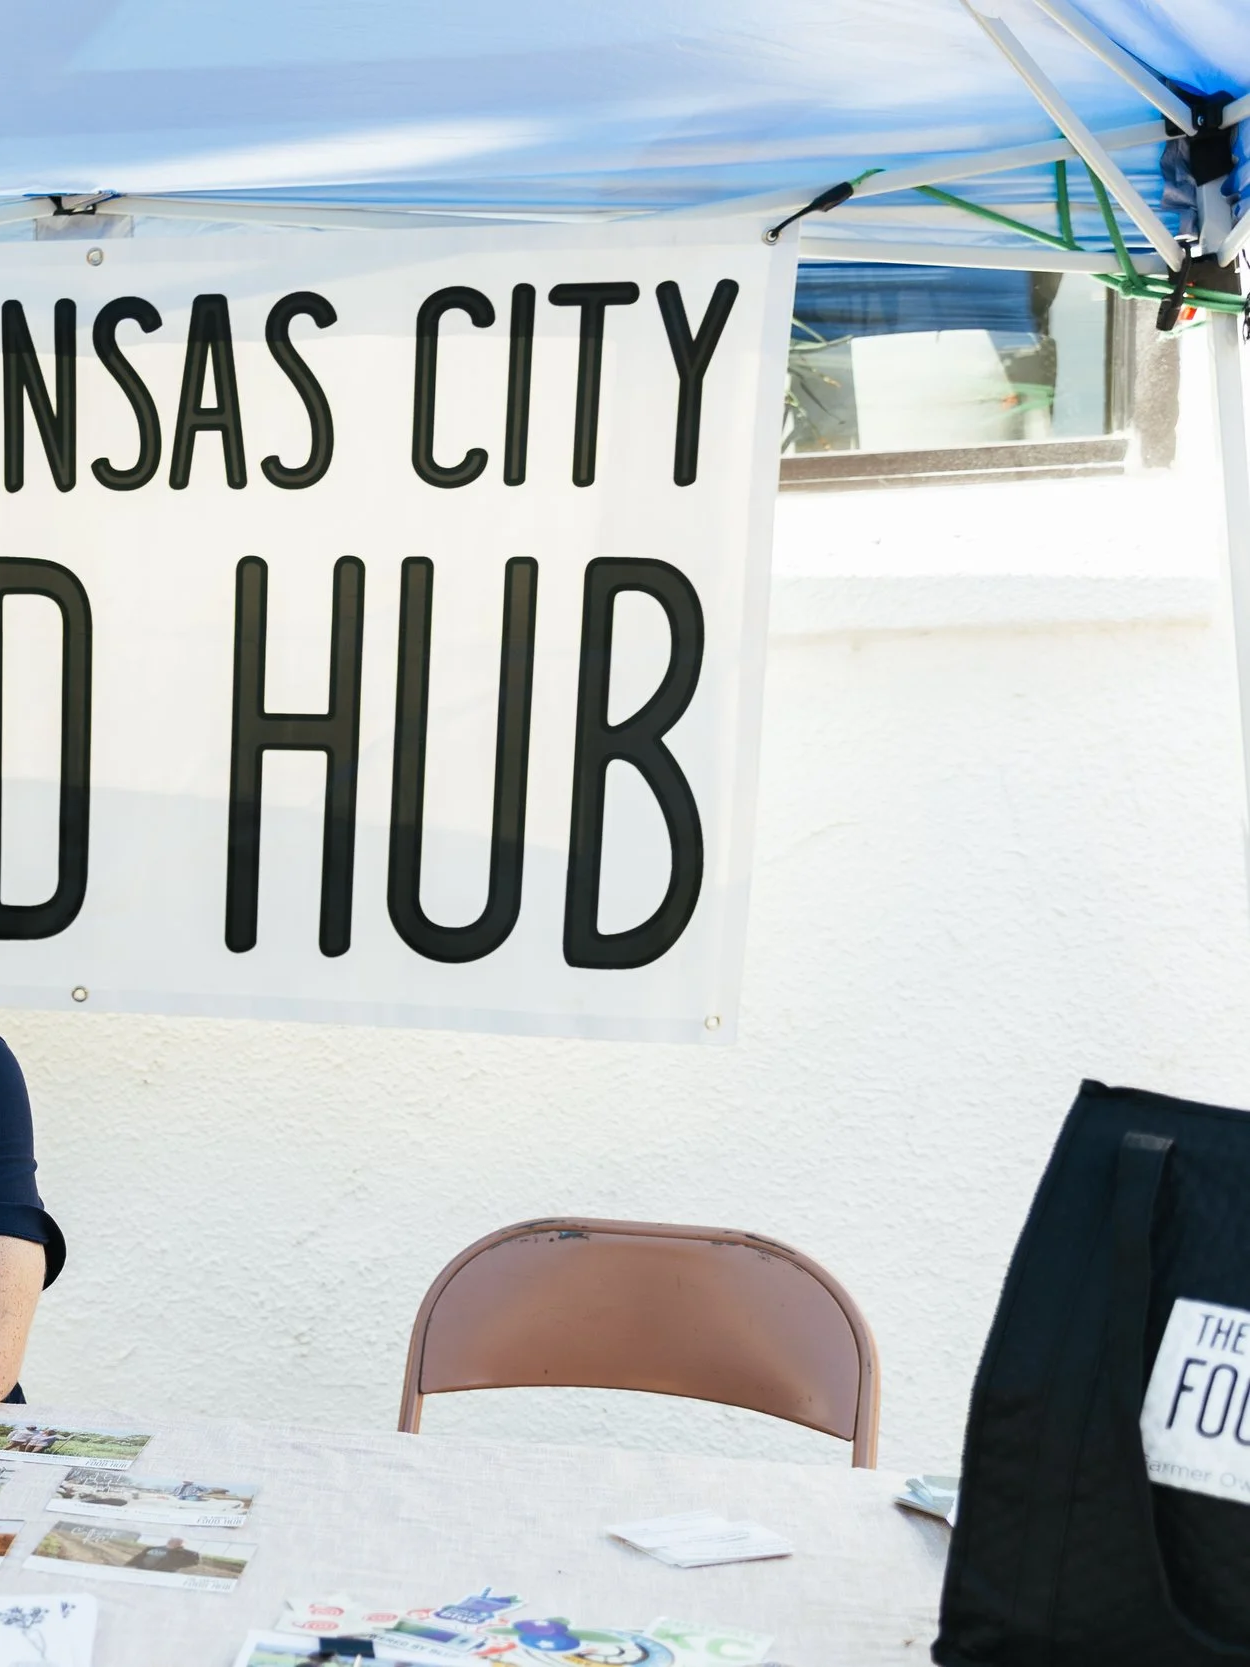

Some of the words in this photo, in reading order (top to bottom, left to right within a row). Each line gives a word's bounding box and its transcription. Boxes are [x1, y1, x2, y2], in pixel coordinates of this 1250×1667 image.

[412, 279, 740, 489] CITY
[225, 556, 705, 970] HUB
[1197, 1313, 1250, 1355] THE
